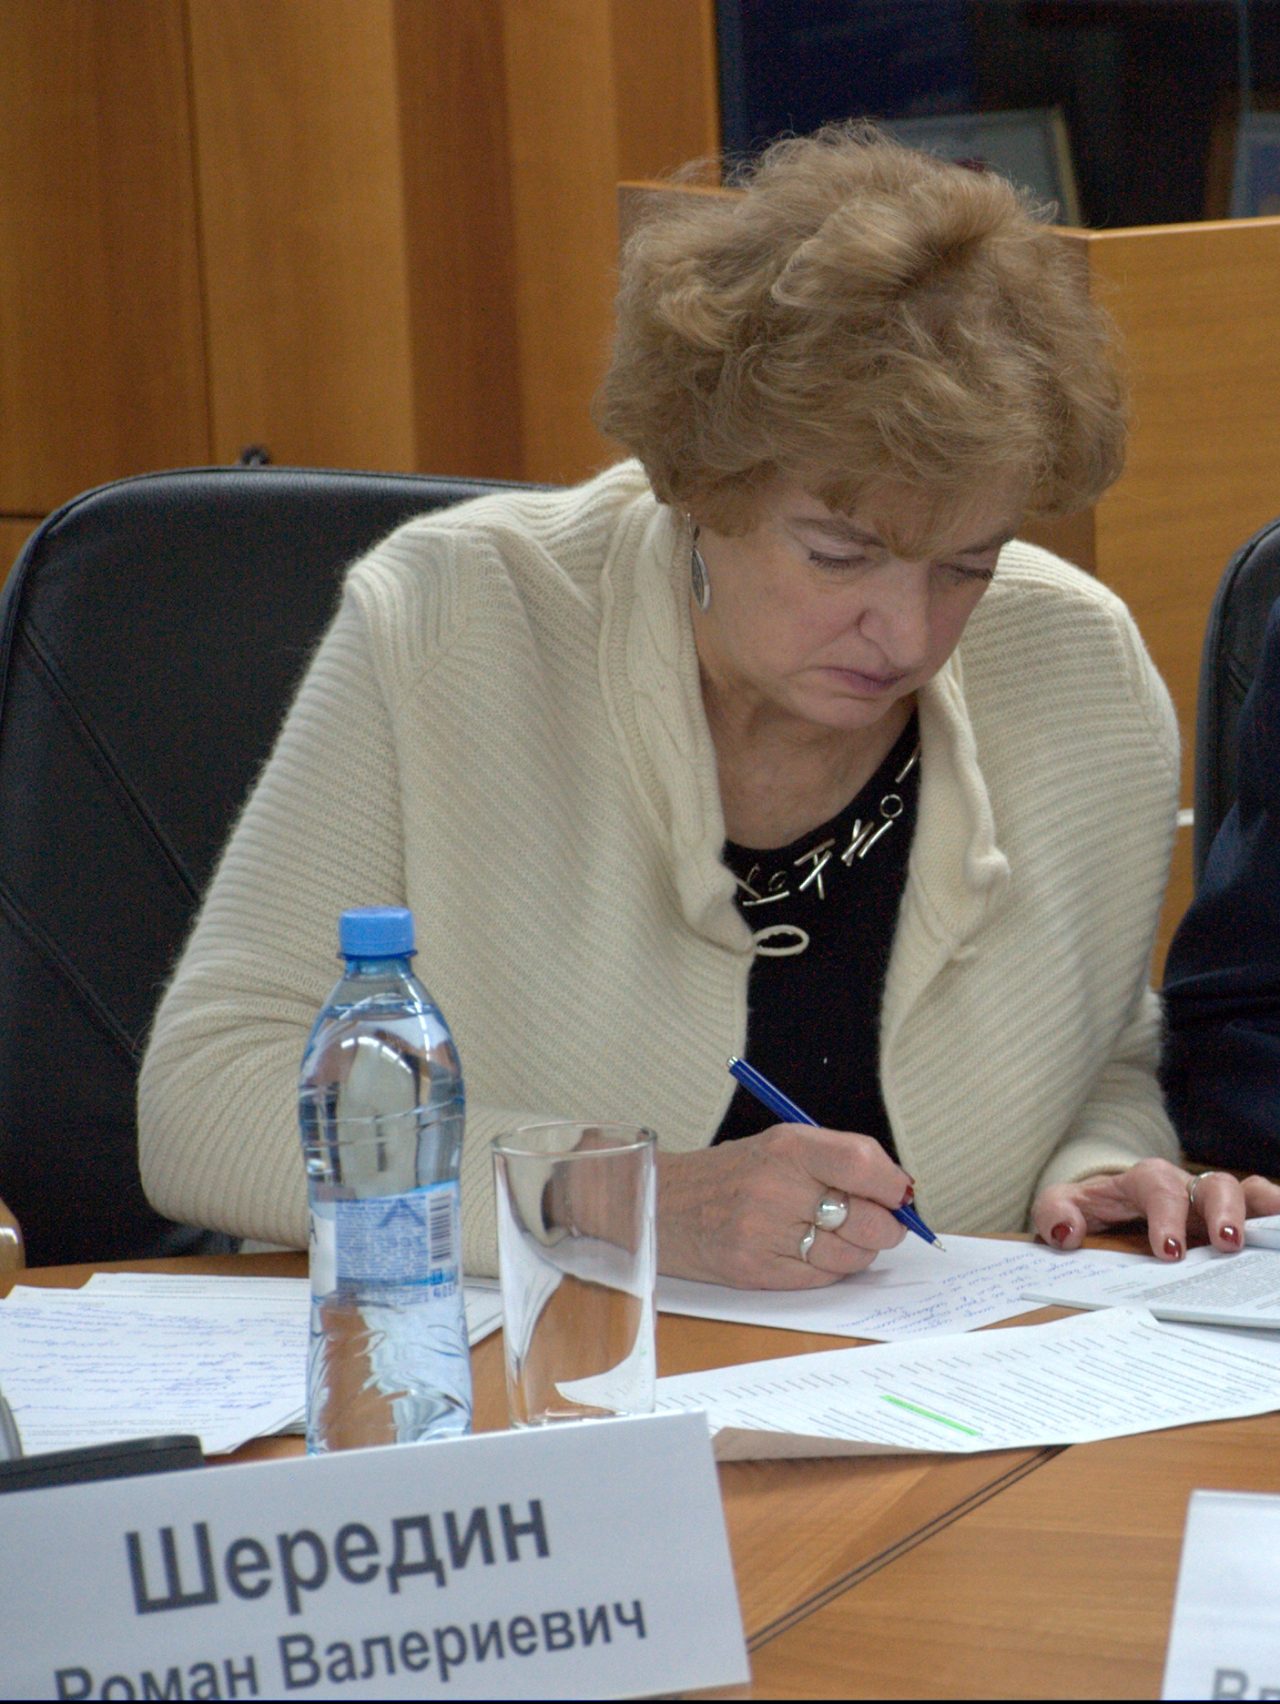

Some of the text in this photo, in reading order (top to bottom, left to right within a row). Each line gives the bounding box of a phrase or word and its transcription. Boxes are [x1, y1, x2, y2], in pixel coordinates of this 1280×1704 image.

[125, 1499, 551, 1615] Шередин
[54, 1599, 648, 1700] Роман Валериевич
